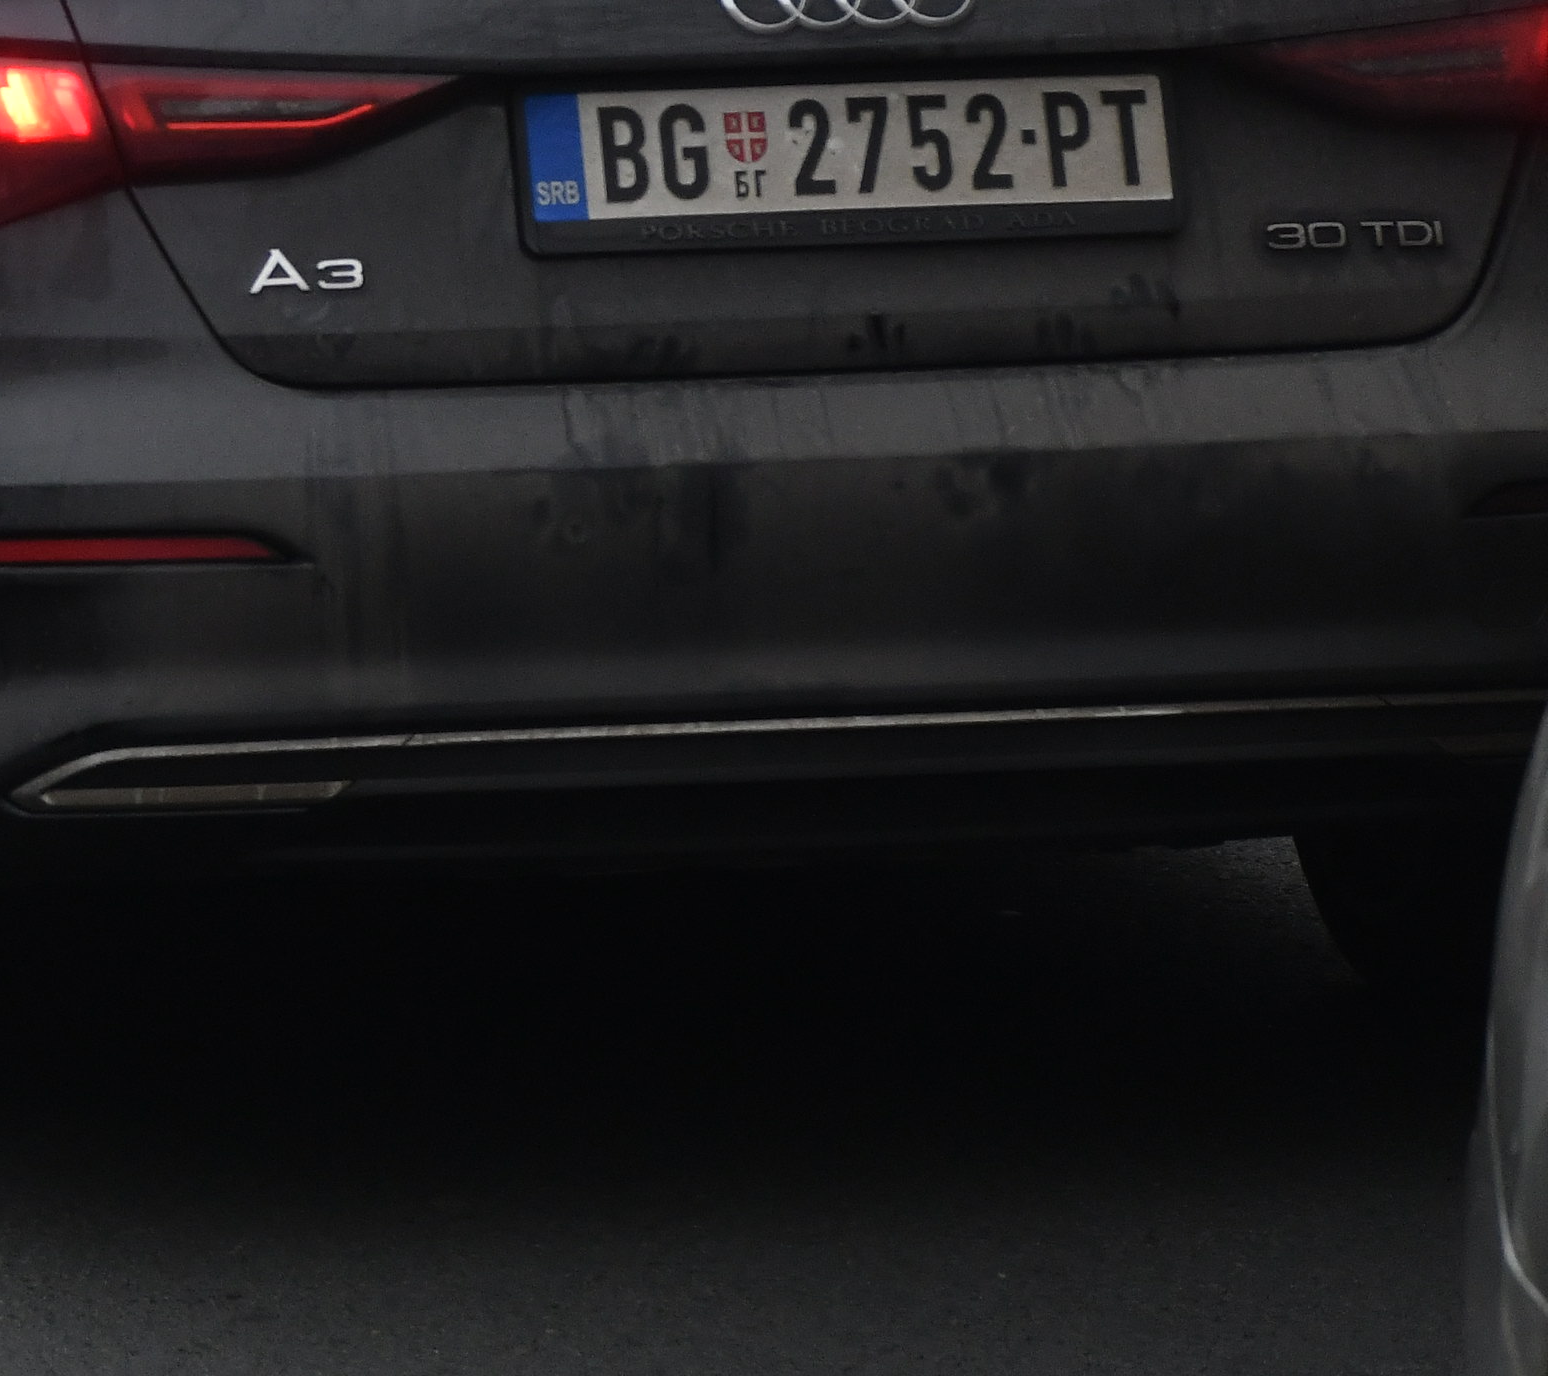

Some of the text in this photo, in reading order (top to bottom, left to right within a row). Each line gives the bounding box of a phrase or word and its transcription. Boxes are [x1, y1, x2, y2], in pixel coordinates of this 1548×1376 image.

[596, 104, 712, 205] BG
[537, 181, 581, 207] SRB
[734, 169, 768, 199] БГ
[640, 218, 798, 241] PORSCHE
[820, 213, 986, 238] BEOGRAD
[1266, 219, 1445, 250] 30 TDI
[249, 248, 365, 295] A3
